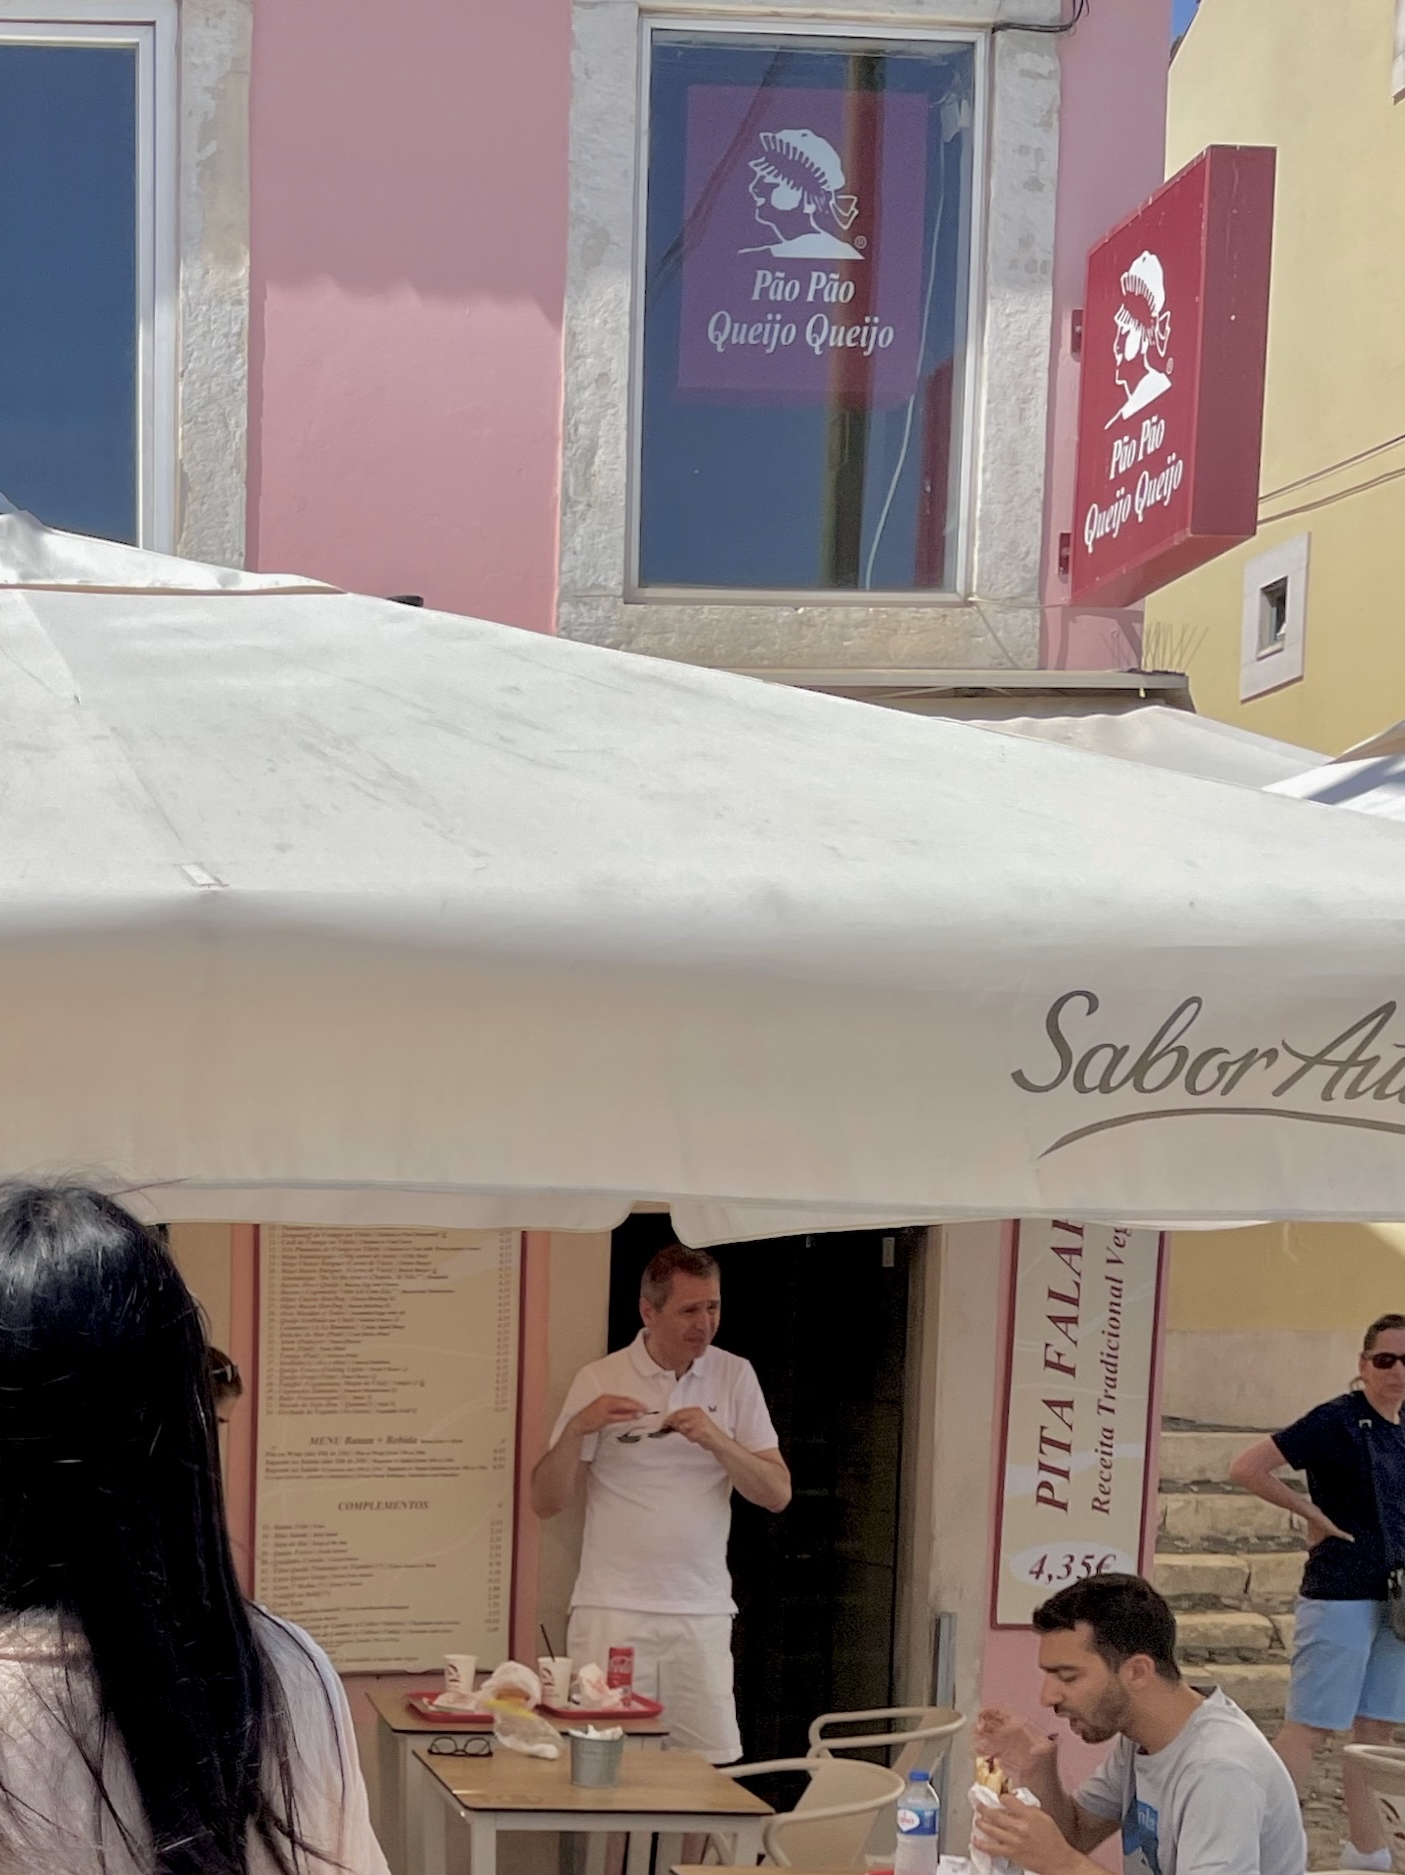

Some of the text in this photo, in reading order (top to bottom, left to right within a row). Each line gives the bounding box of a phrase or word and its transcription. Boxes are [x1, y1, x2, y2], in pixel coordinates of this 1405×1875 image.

[751, 269, 855, 303] Pão Pão
[707, 310, 894, 356] Queijo Queijo
[1109, 414, 1165, 480] Pão Pão
[1084, 452, 1183, 554] Queijo Queijo
[1097, 1274, 1124, 1417] Tradicional
[1035, 1397, 1075, 1514] PITA
[1091, 1426, 1116, 1515] Receita
[338, 1501, 429, 1511] COMPLEMENTOS
[1029, 1554, 1116, 1584] 4,35€
